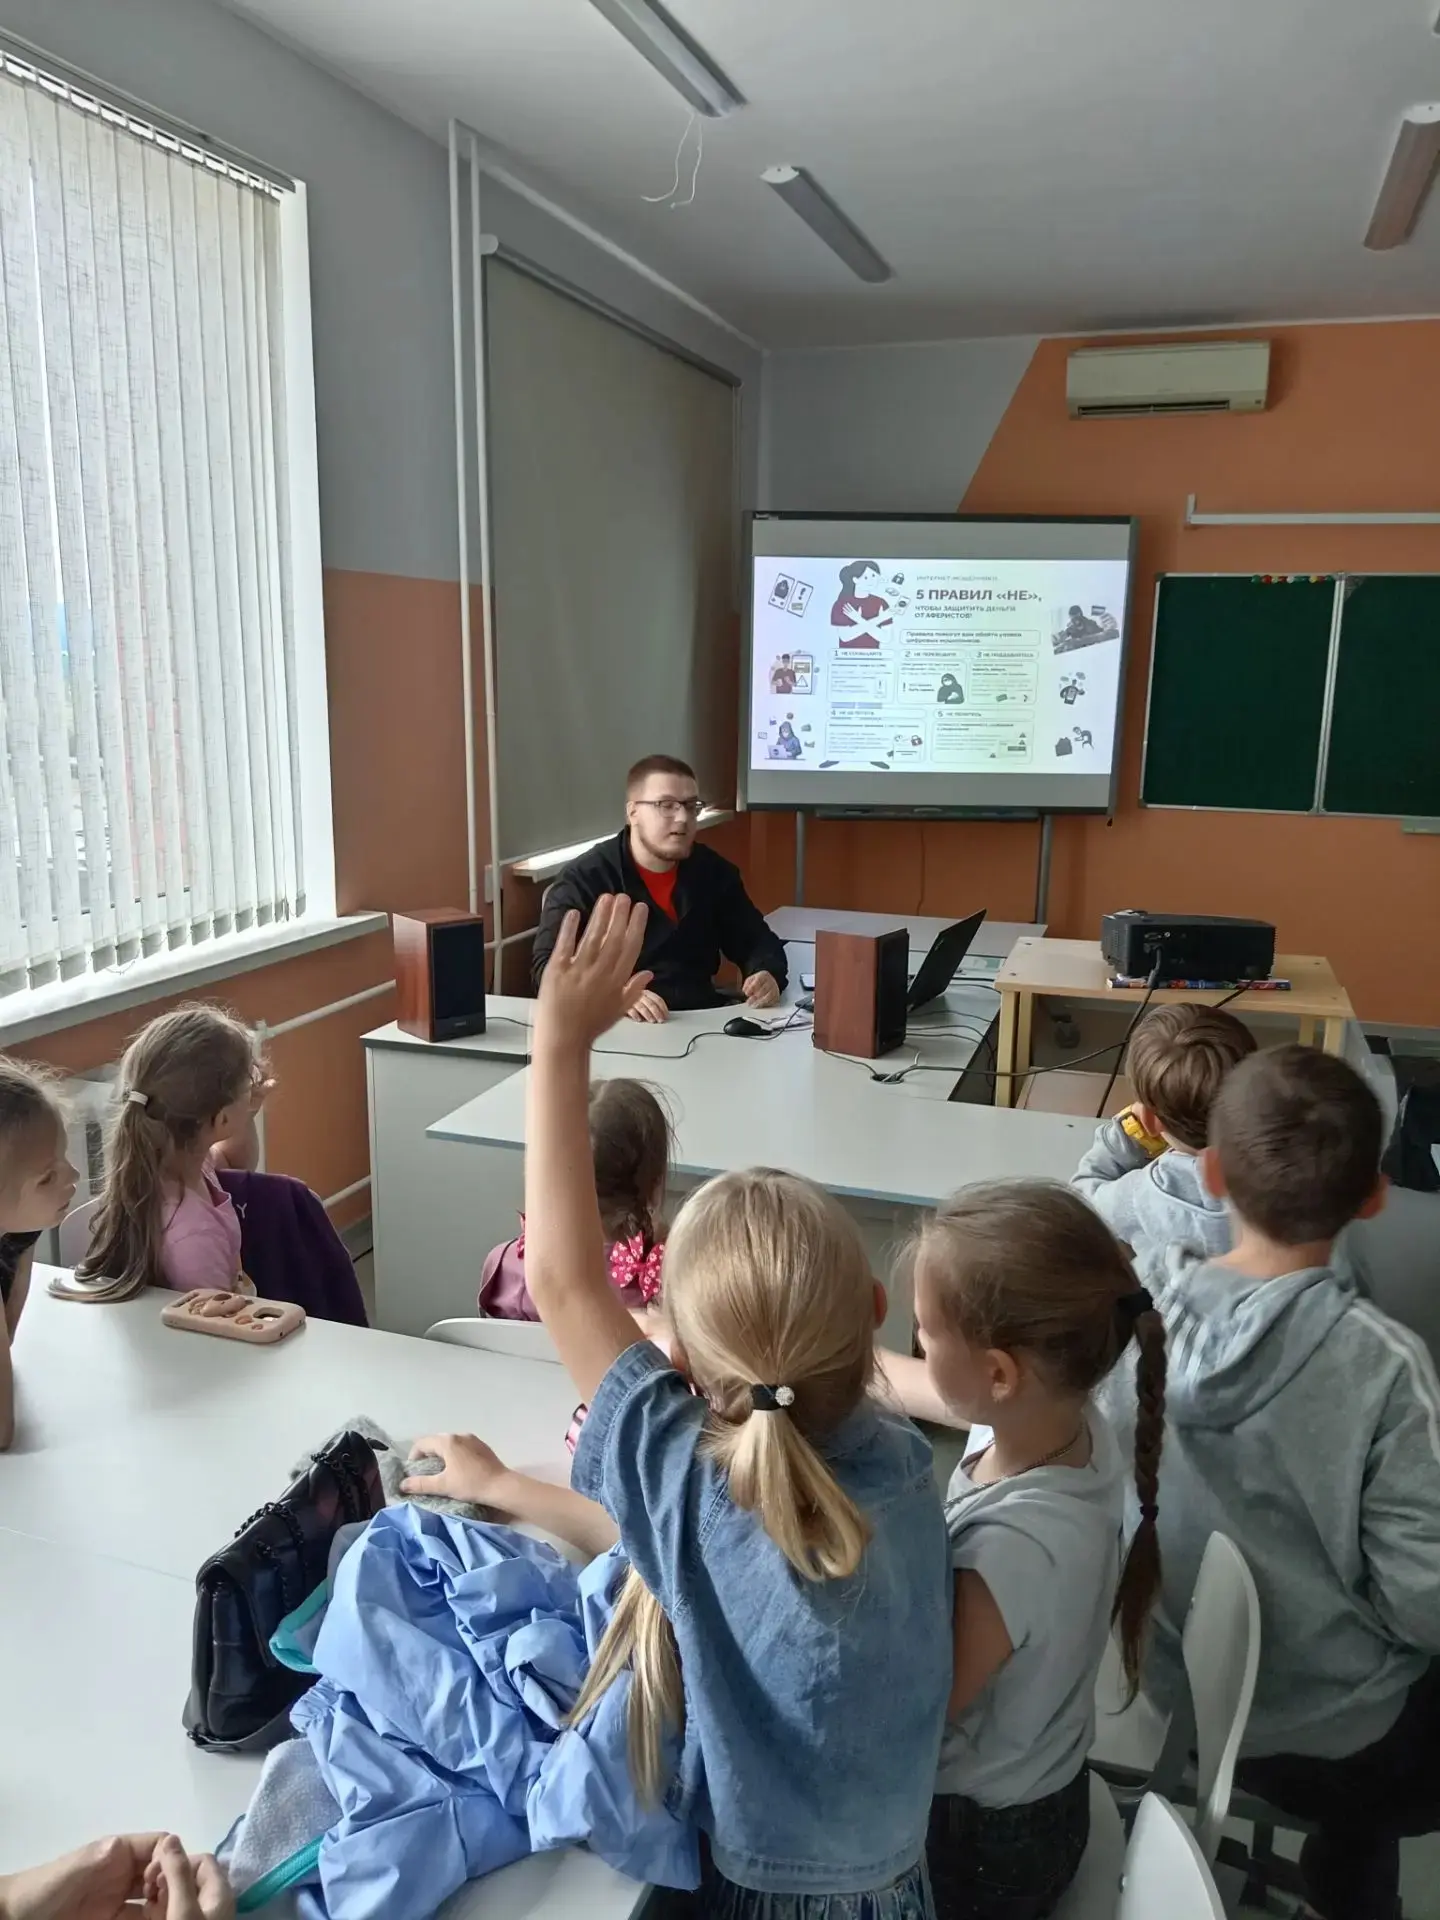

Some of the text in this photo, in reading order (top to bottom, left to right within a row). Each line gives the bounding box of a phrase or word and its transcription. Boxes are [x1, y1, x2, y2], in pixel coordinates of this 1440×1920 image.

[916, 589, 925, 600] 5
[928, 589, 993, 601] ПРАВИЛ
[943, 605, 984, 613] ЗАЩИТИТЬ
[985, 605, 1016, 613] ДЕНЬГИ
